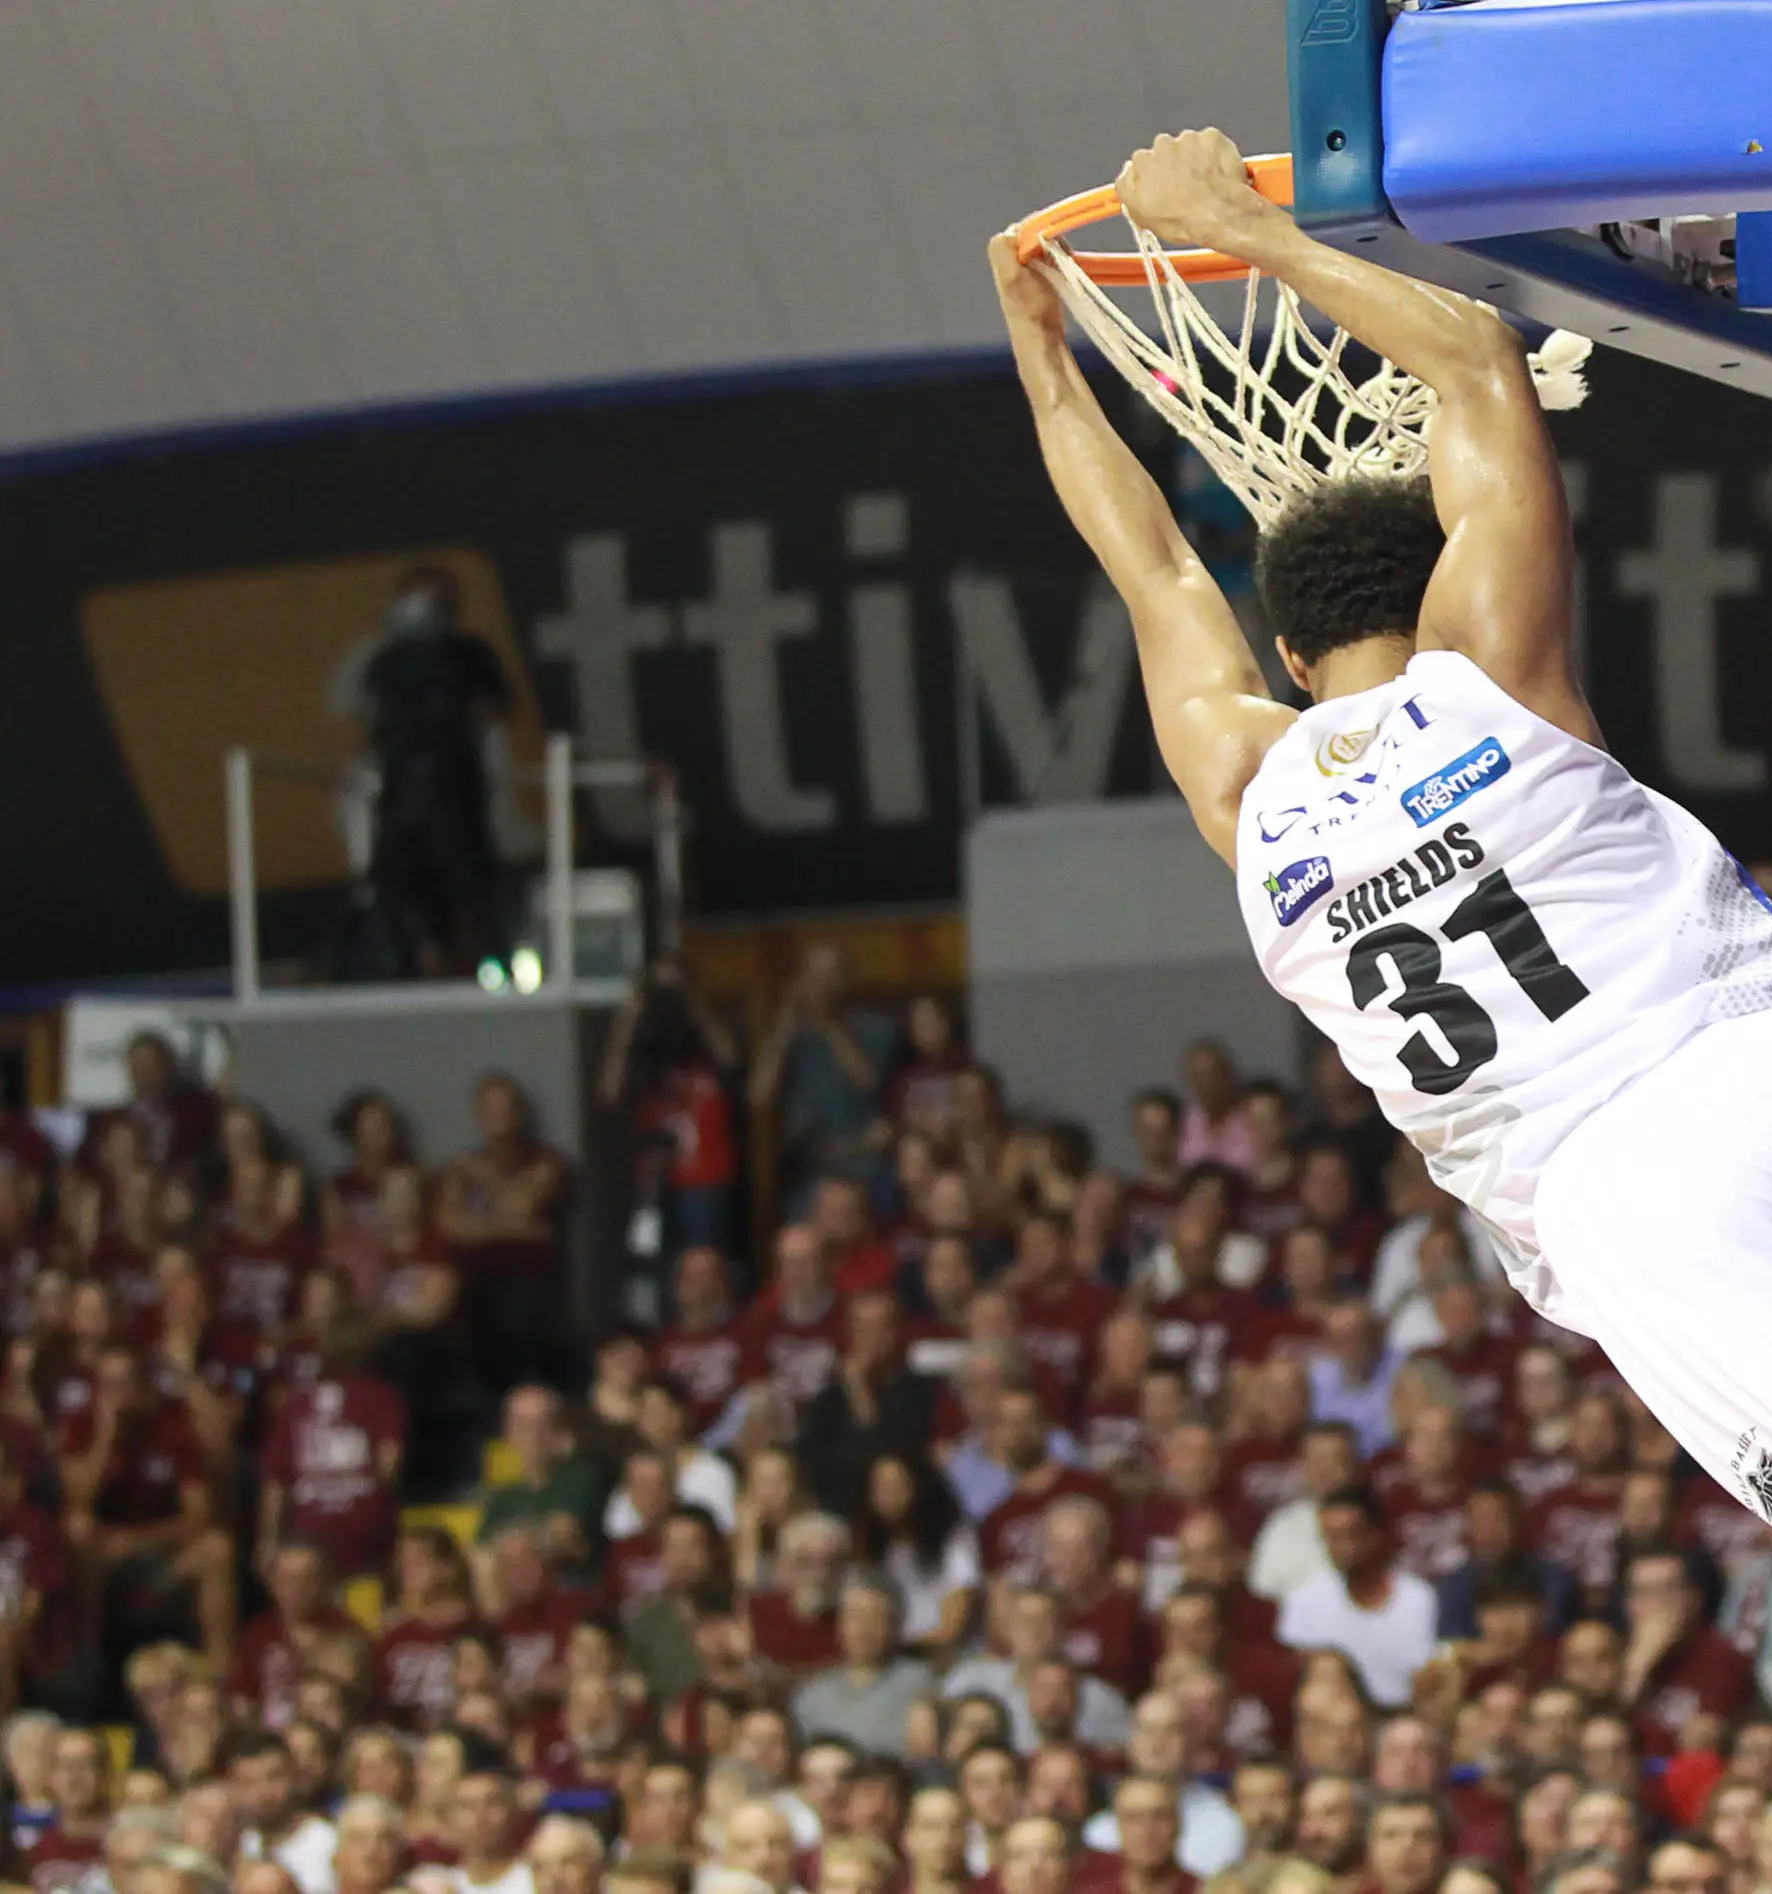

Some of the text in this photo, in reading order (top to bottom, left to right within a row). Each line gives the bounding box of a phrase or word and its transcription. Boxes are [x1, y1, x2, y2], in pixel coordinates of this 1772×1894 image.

[1406, 748, 1500, 819] TRENTINO
[1274, 862, 1330, 918] Melinda
[1326, 822, 1486, 943] SHIELDS
[1346, 867, 1590, 1095] 31
